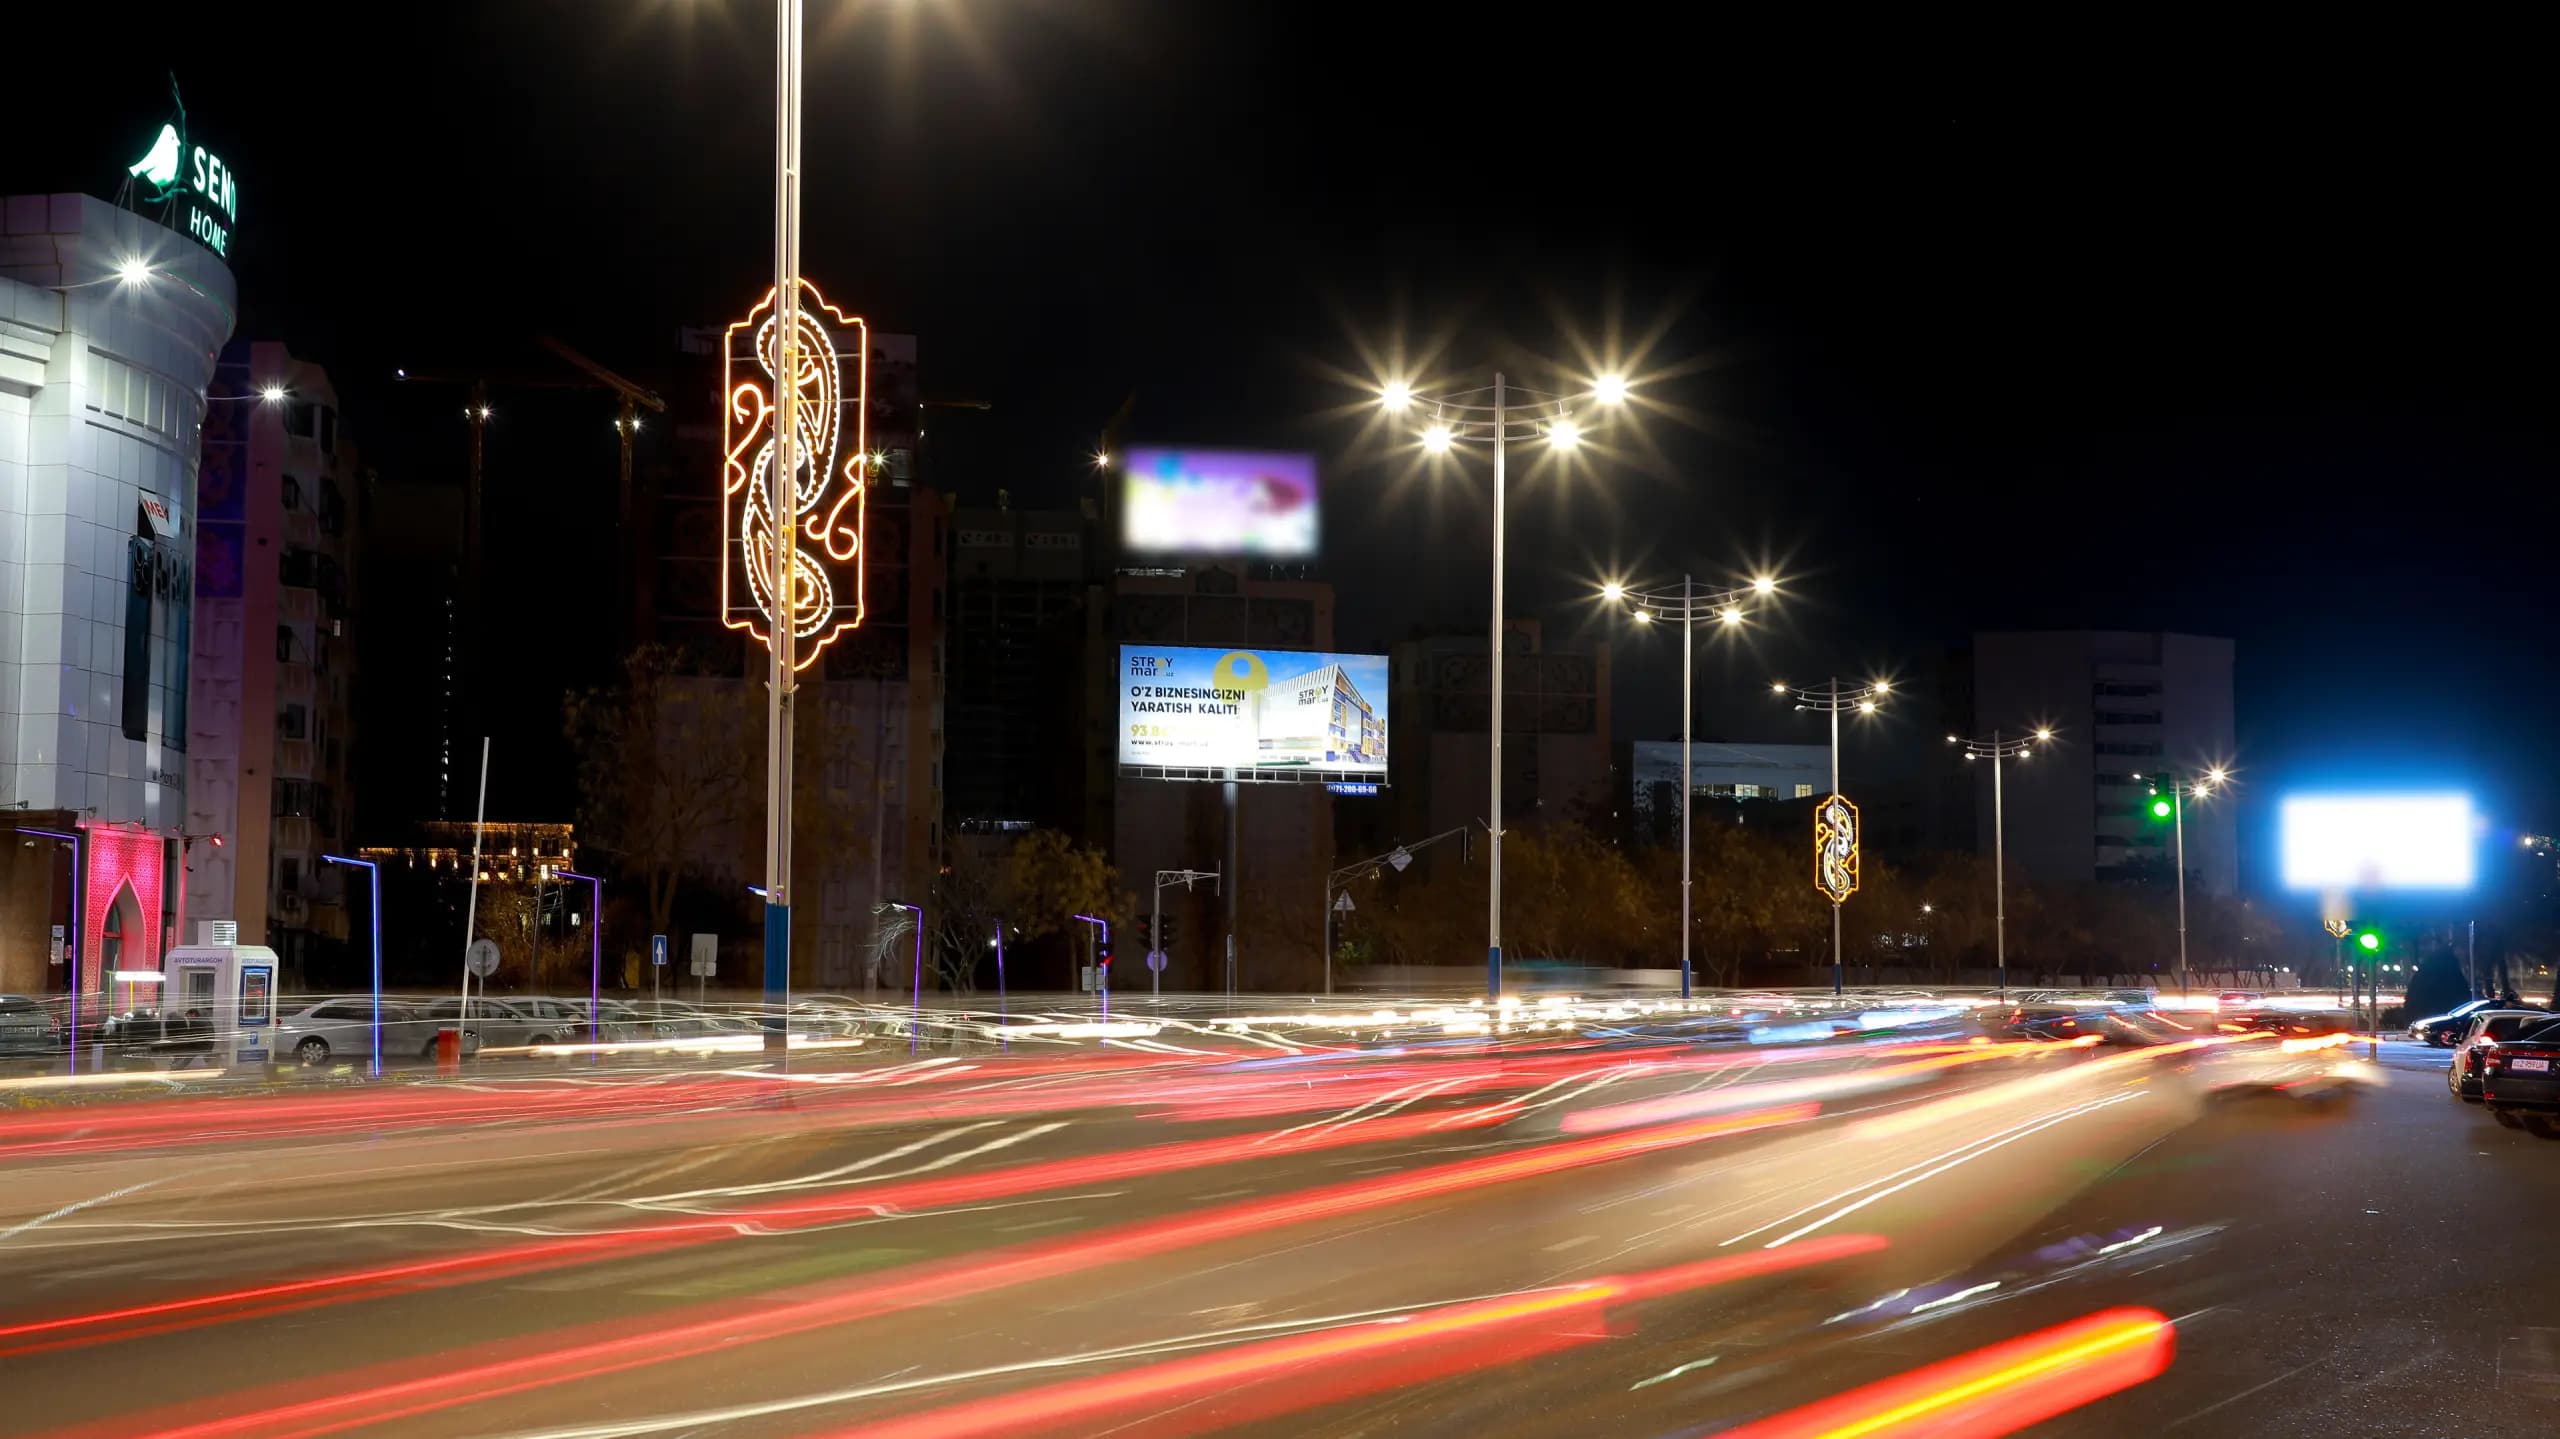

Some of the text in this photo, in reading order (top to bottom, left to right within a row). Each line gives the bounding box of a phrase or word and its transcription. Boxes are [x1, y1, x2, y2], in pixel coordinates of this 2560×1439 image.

[190, 205, 228, 258] HOME
[1131, 686, 1245, 700] O'Z BIZNESINGIZNI
[1131, 701, 1192, 714] YARATISH
[1131, 724, 1148, 737] 93
